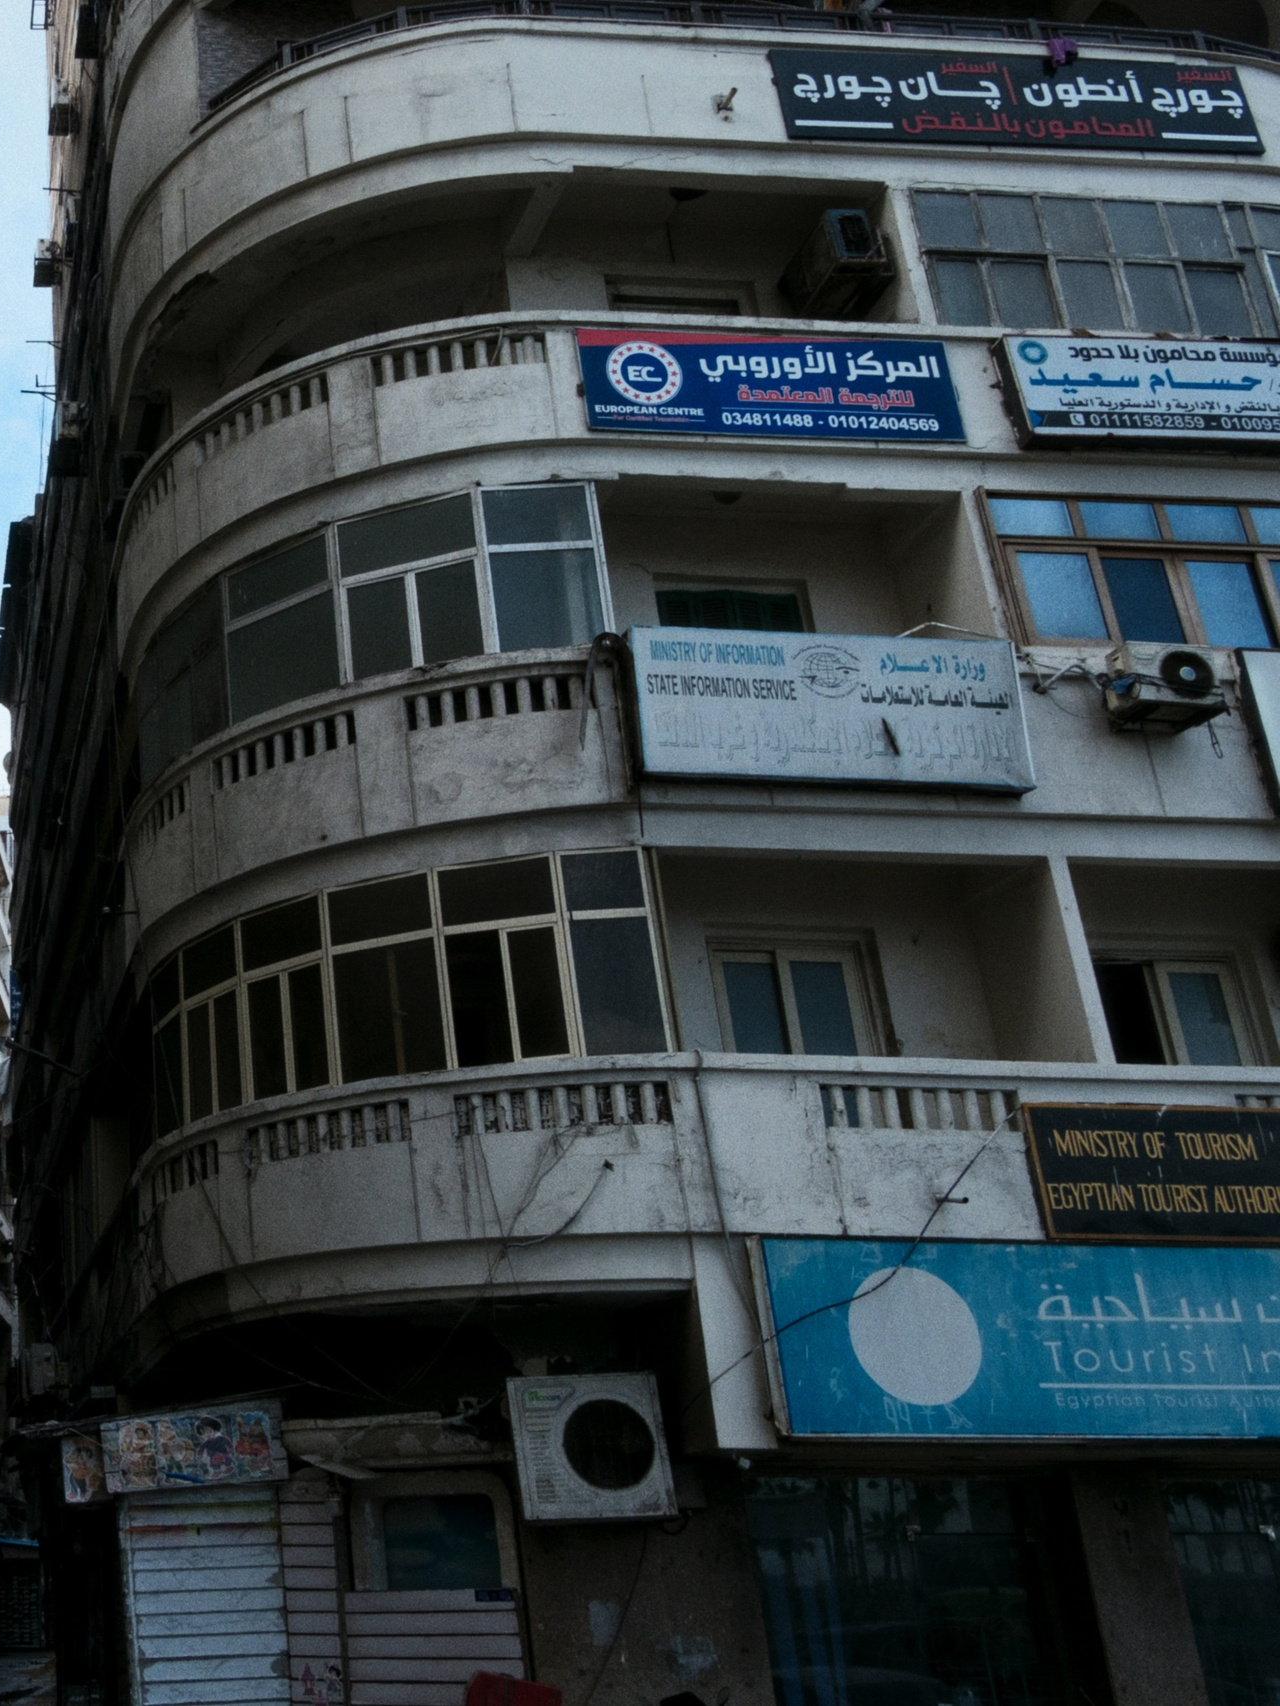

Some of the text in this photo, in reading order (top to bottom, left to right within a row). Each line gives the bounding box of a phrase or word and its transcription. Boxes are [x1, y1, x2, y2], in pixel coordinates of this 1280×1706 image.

[1022, 70, 1144, 109] أنطون
[901, 110, 1156, 141] المحامون بالنقض
[699, 345, 941, 383] المركز الأوروبي
[1068, 346, 1115, 361] حدود
[1119, 345, 1140, 363] بلا
[1144, 345, 1216, 363] محامون
[627, 366, 663, 382] EC
[1029, 368, 1140, 394] سعيد
[1149, 368, 1262, 394] حسام
[594, 404, 705, 417] EUROPEAN CENTRE
[736, 385, 916, 411] للترجمة المعتمدة
[721, 411, 814, 428] 034811488
[827, 415, 940, 432] 01012404569
[1089, 413, 1205, 429] 01111582859
[649, 639, 696, 662] MINISTRY
[699, 642, 712, 663] OF
[715, 643, 785, 666] INFORMATION
[953, 654, 987, 682] وزارة
[646, 673, 679, 695] STATE
[680, 675, 750, 699] INFORMATION
[752, 678, 798, 701] SERVICE
[1053, 1129, 1258, 1161] MINISTRY OF TOURISM
[1047, 1183, 1136, 1211] EGYPTIAN
[1138, 1184, 1209, 1213] TOURIST
[1043, 1341, 1215, 1373] Tourist
[1055, 1393, 1145, 1410] Egyptian
[1153, 1394, 1218, 1408] Tourist
